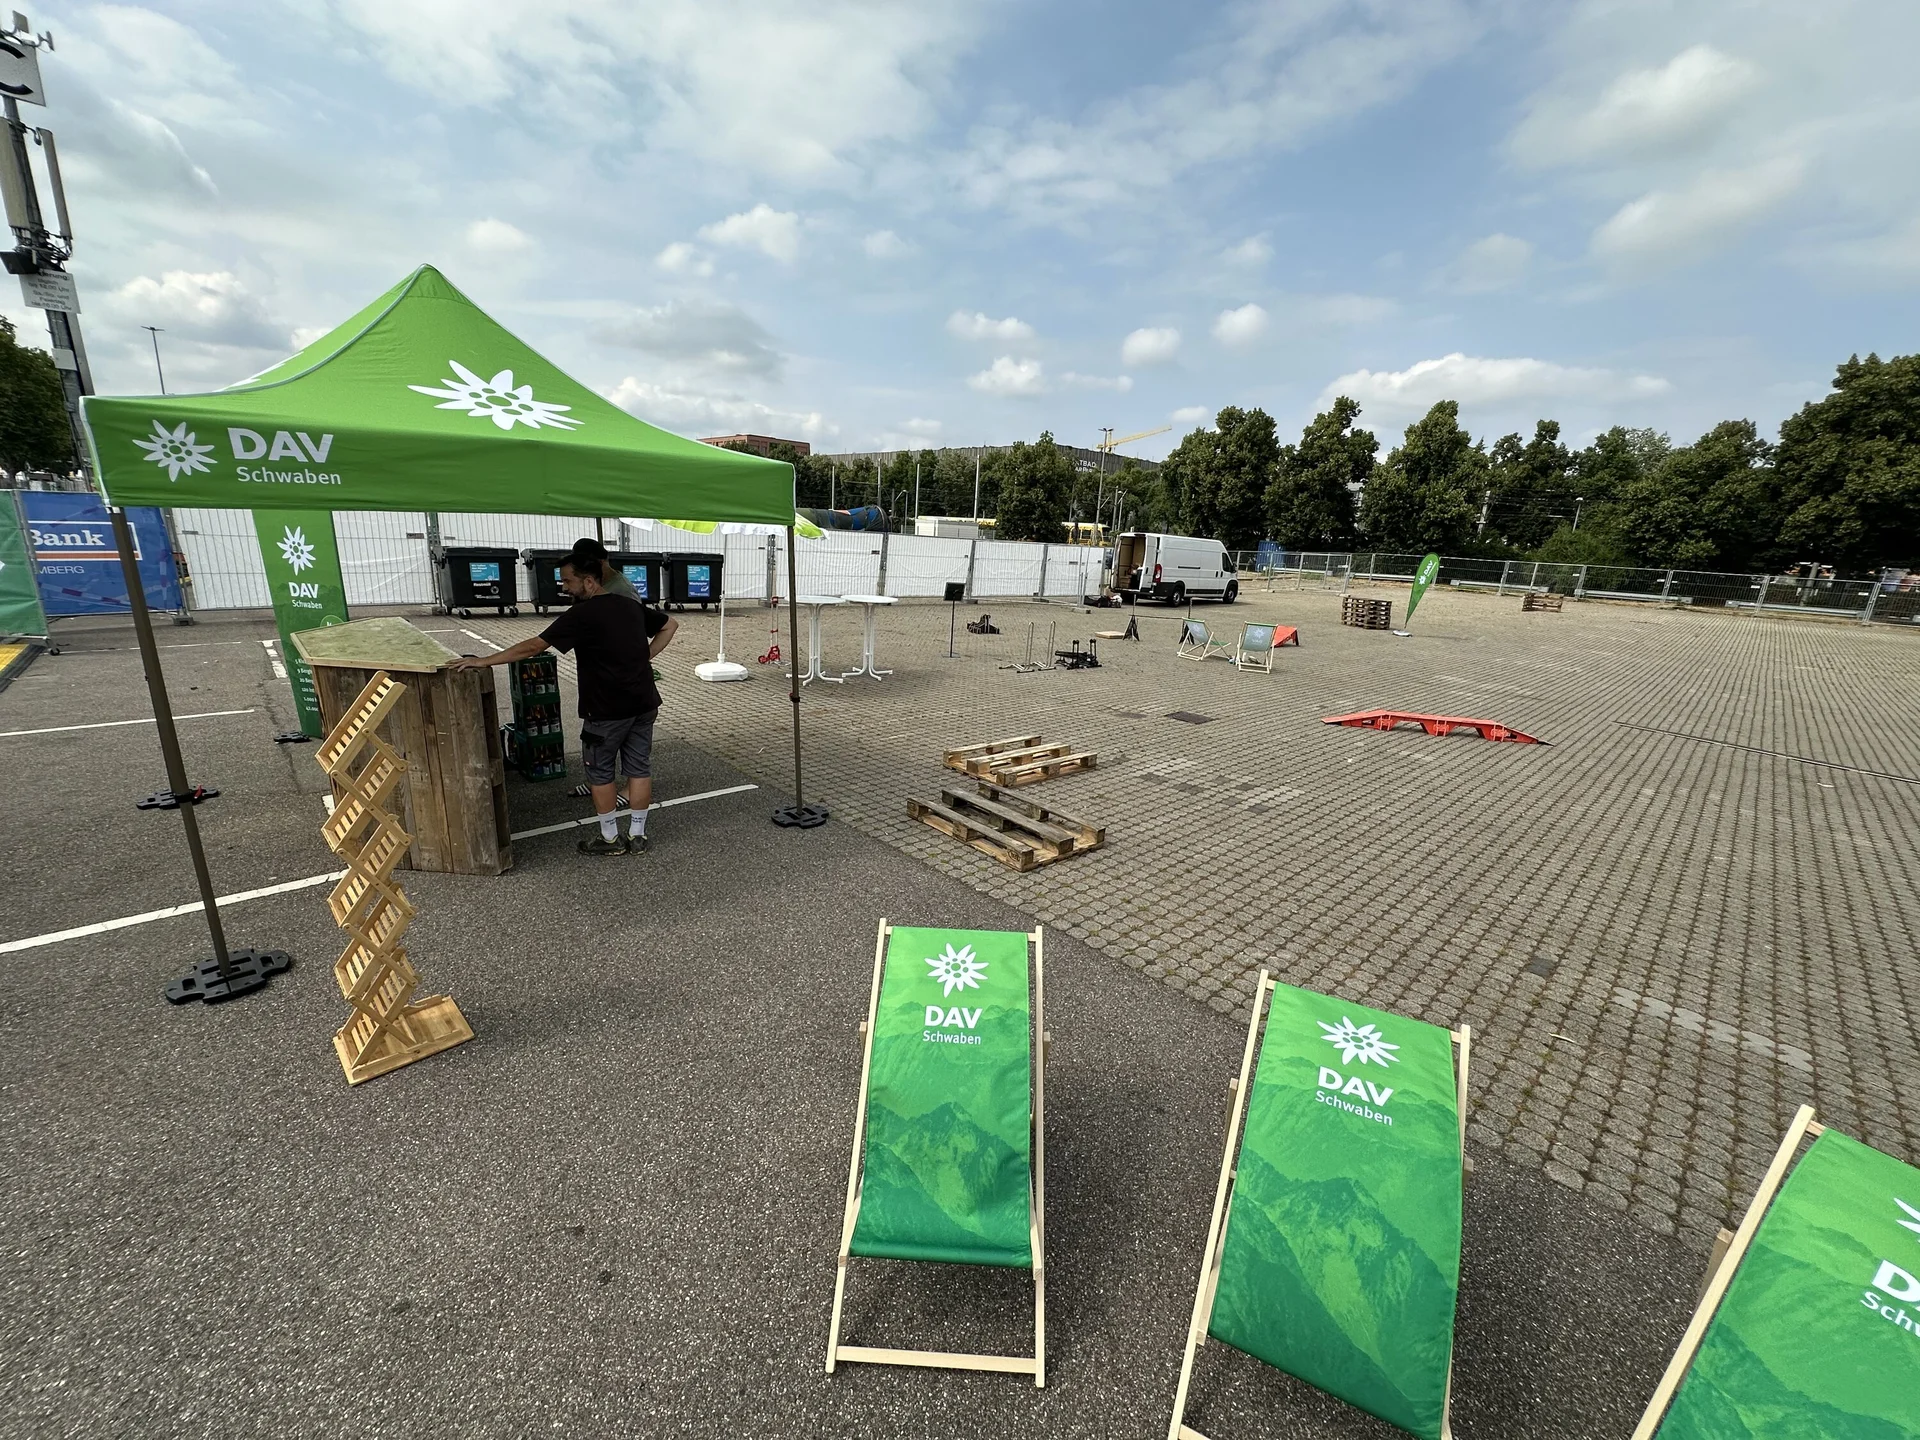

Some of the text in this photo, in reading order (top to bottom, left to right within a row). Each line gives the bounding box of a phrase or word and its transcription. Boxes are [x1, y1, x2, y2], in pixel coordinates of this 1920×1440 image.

[227, 427, 334, 463] DAV
[236, 466, 342, 485] Schwaben
[288, 581, 319, 599] DAV
[291, 599, 323, 609] Schwaben
[924, 1005, 983, 1029] DAV
[922, 1029, 981, 1045] Schwaben
[1317, 1065, 1395, 1107] DAV
[1315, 1090, 1393, 1127] Schwaben
[1871, 1259, 1920, 1312] D
